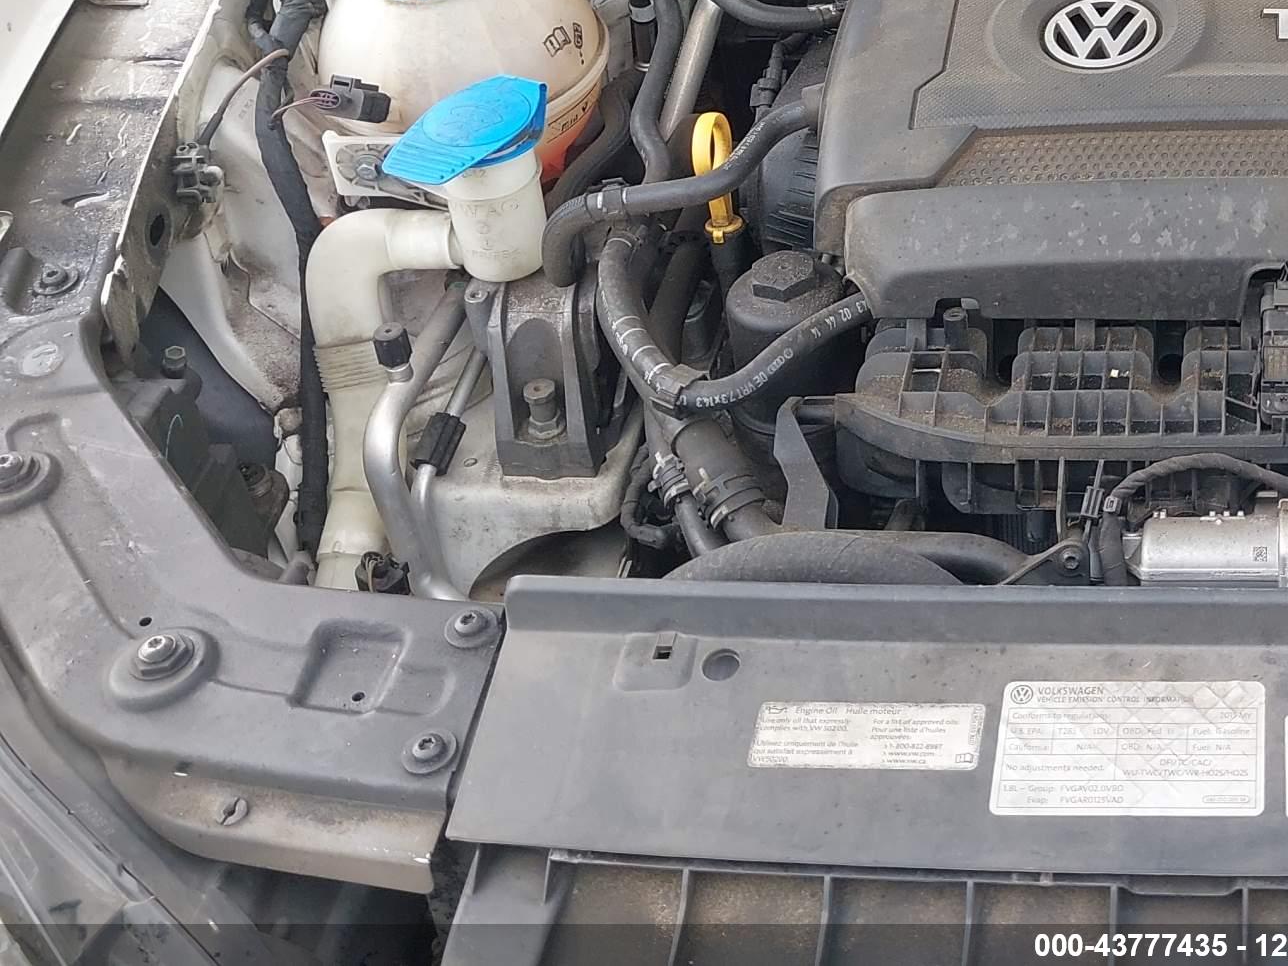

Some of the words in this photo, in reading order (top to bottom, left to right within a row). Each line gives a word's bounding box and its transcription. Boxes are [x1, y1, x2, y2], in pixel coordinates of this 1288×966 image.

[1037, 686, 1104, 695] VOLKSWAGEN
[1037, 696, 1066, 704] VEHICLE
[1068, 696, 1103, 704] EMISSION
[1106, 696, 1140, 704] CONTROL
[795, 707, 824, 715] Engine
[825, 707, 838, 715] Oil
[846, 707, 868, 715] Huile
[870, 707, 902, 715] moteur
[1006, 763, 1019, 773] No
[1021, 763, 1071, 773] adjustments
